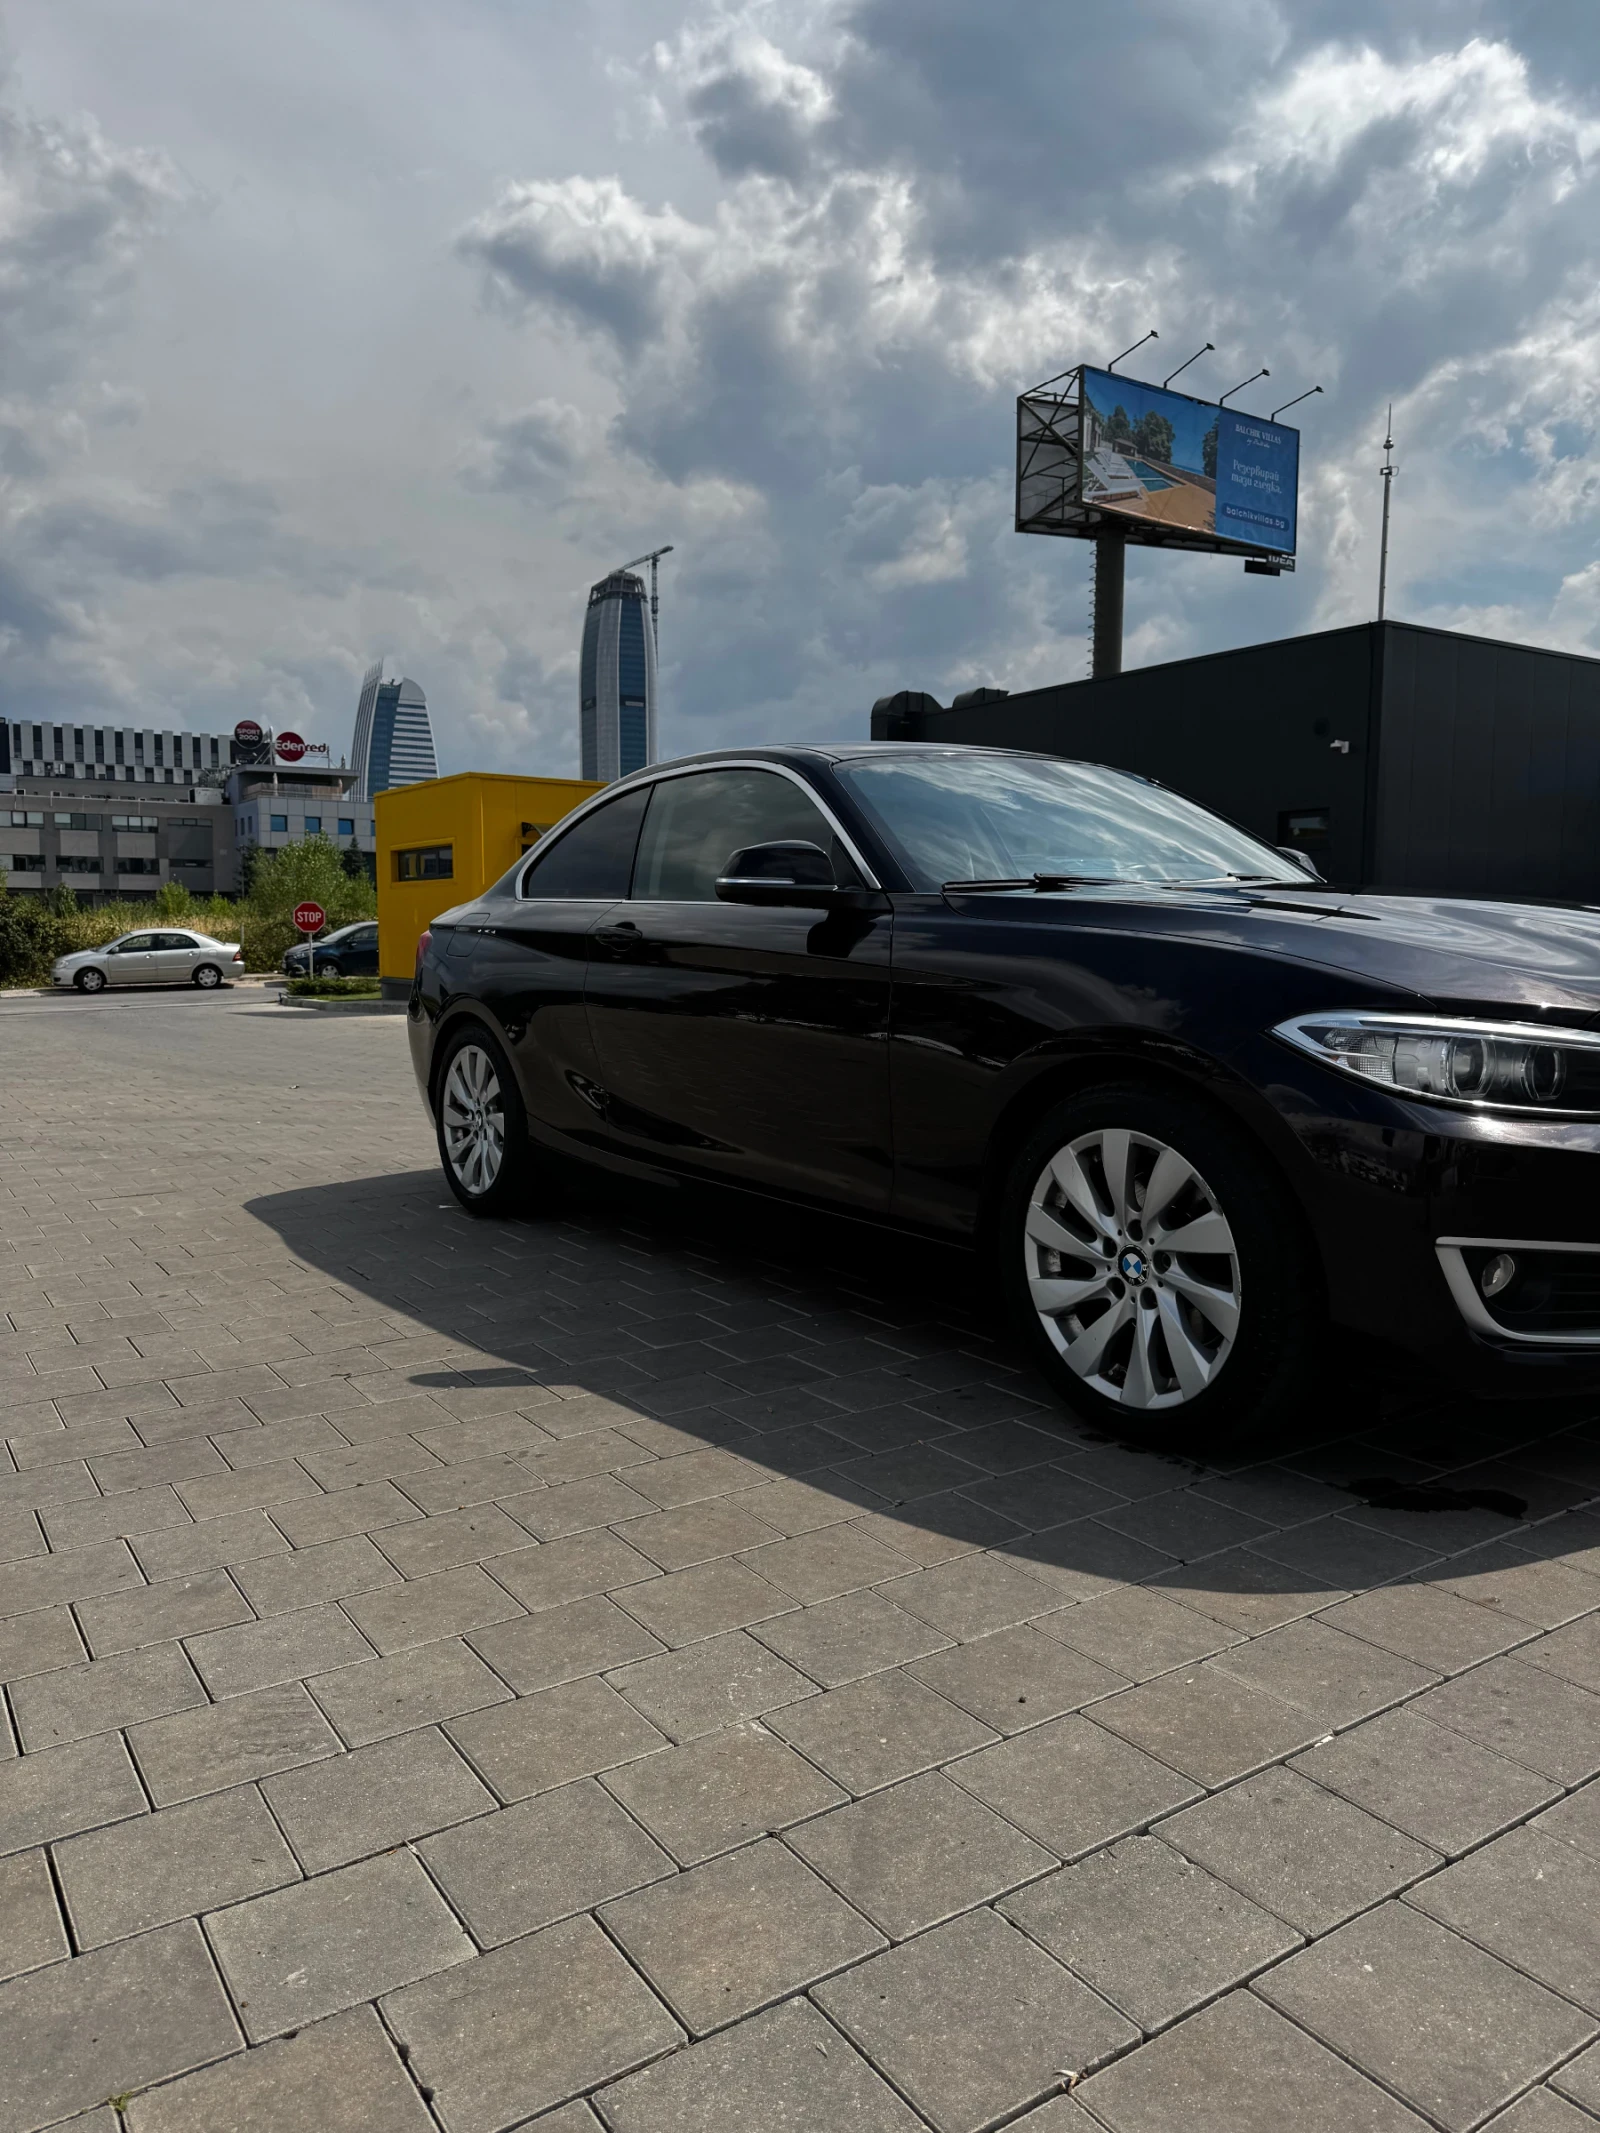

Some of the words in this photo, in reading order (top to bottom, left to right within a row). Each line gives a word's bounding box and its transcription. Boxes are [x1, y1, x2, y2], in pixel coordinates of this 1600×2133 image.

[1235, 424, 1261, 439] BALCHIK
[1262, 431, 1282, 445] VILLAS
[1233, 458, 1280, 481] Резервирай
[1231, 473, 1252, 487] тази
[1253, 479, 1282, 494] гледка.
[1226, 506, 1285, 529] balchikvillas.bg
[275, 739, 327, 753] Edenred
[297, 911, 322, 923] STOP
